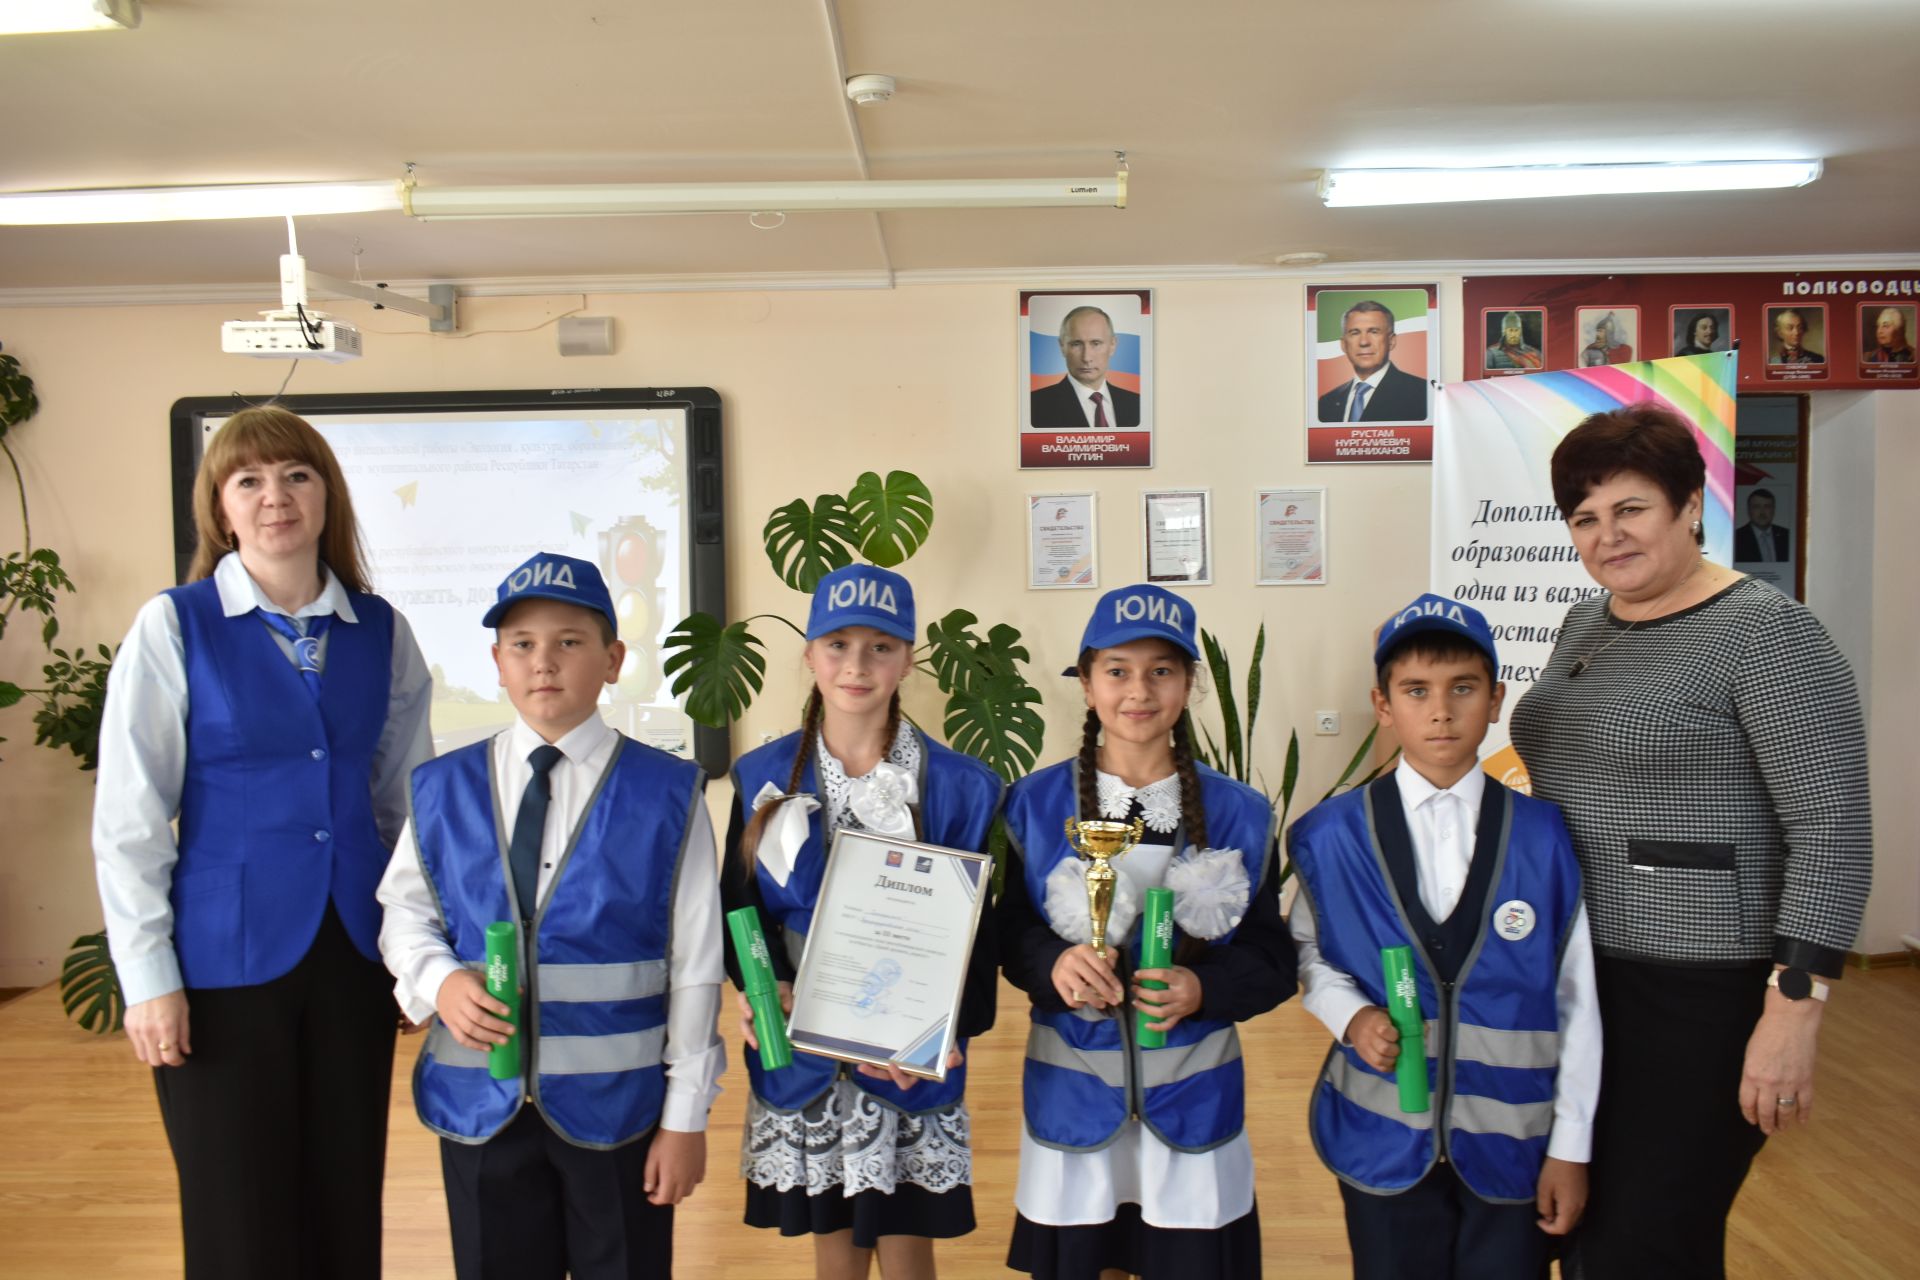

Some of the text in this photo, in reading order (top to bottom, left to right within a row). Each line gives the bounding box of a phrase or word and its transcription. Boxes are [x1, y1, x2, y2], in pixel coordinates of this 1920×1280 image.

[1351, 429, 1395, 438] РУСТАМ
[1055, 435, 1116, 444] ВЛАДИМИР
[1335, 438, 1411, 447] НУРГАЛИЕВИЧ
[1041, 444, 1130, 453] ВЛАДИМИРОВИЧ
[1336, 447, 1410, 456] МИННИХАНОВ
[1068, 453, 1104, 461] ПУТИН
[507, 562, 577, 597] ЮИД
[1454, 578, 1506, 602] одна
[1514, 585, 1538, 602] из
[828, 578, 898, 615] ЮИД
[1115, 595, 1183, 633] ЮИД
[874, 874, 934, 897] Диплом
